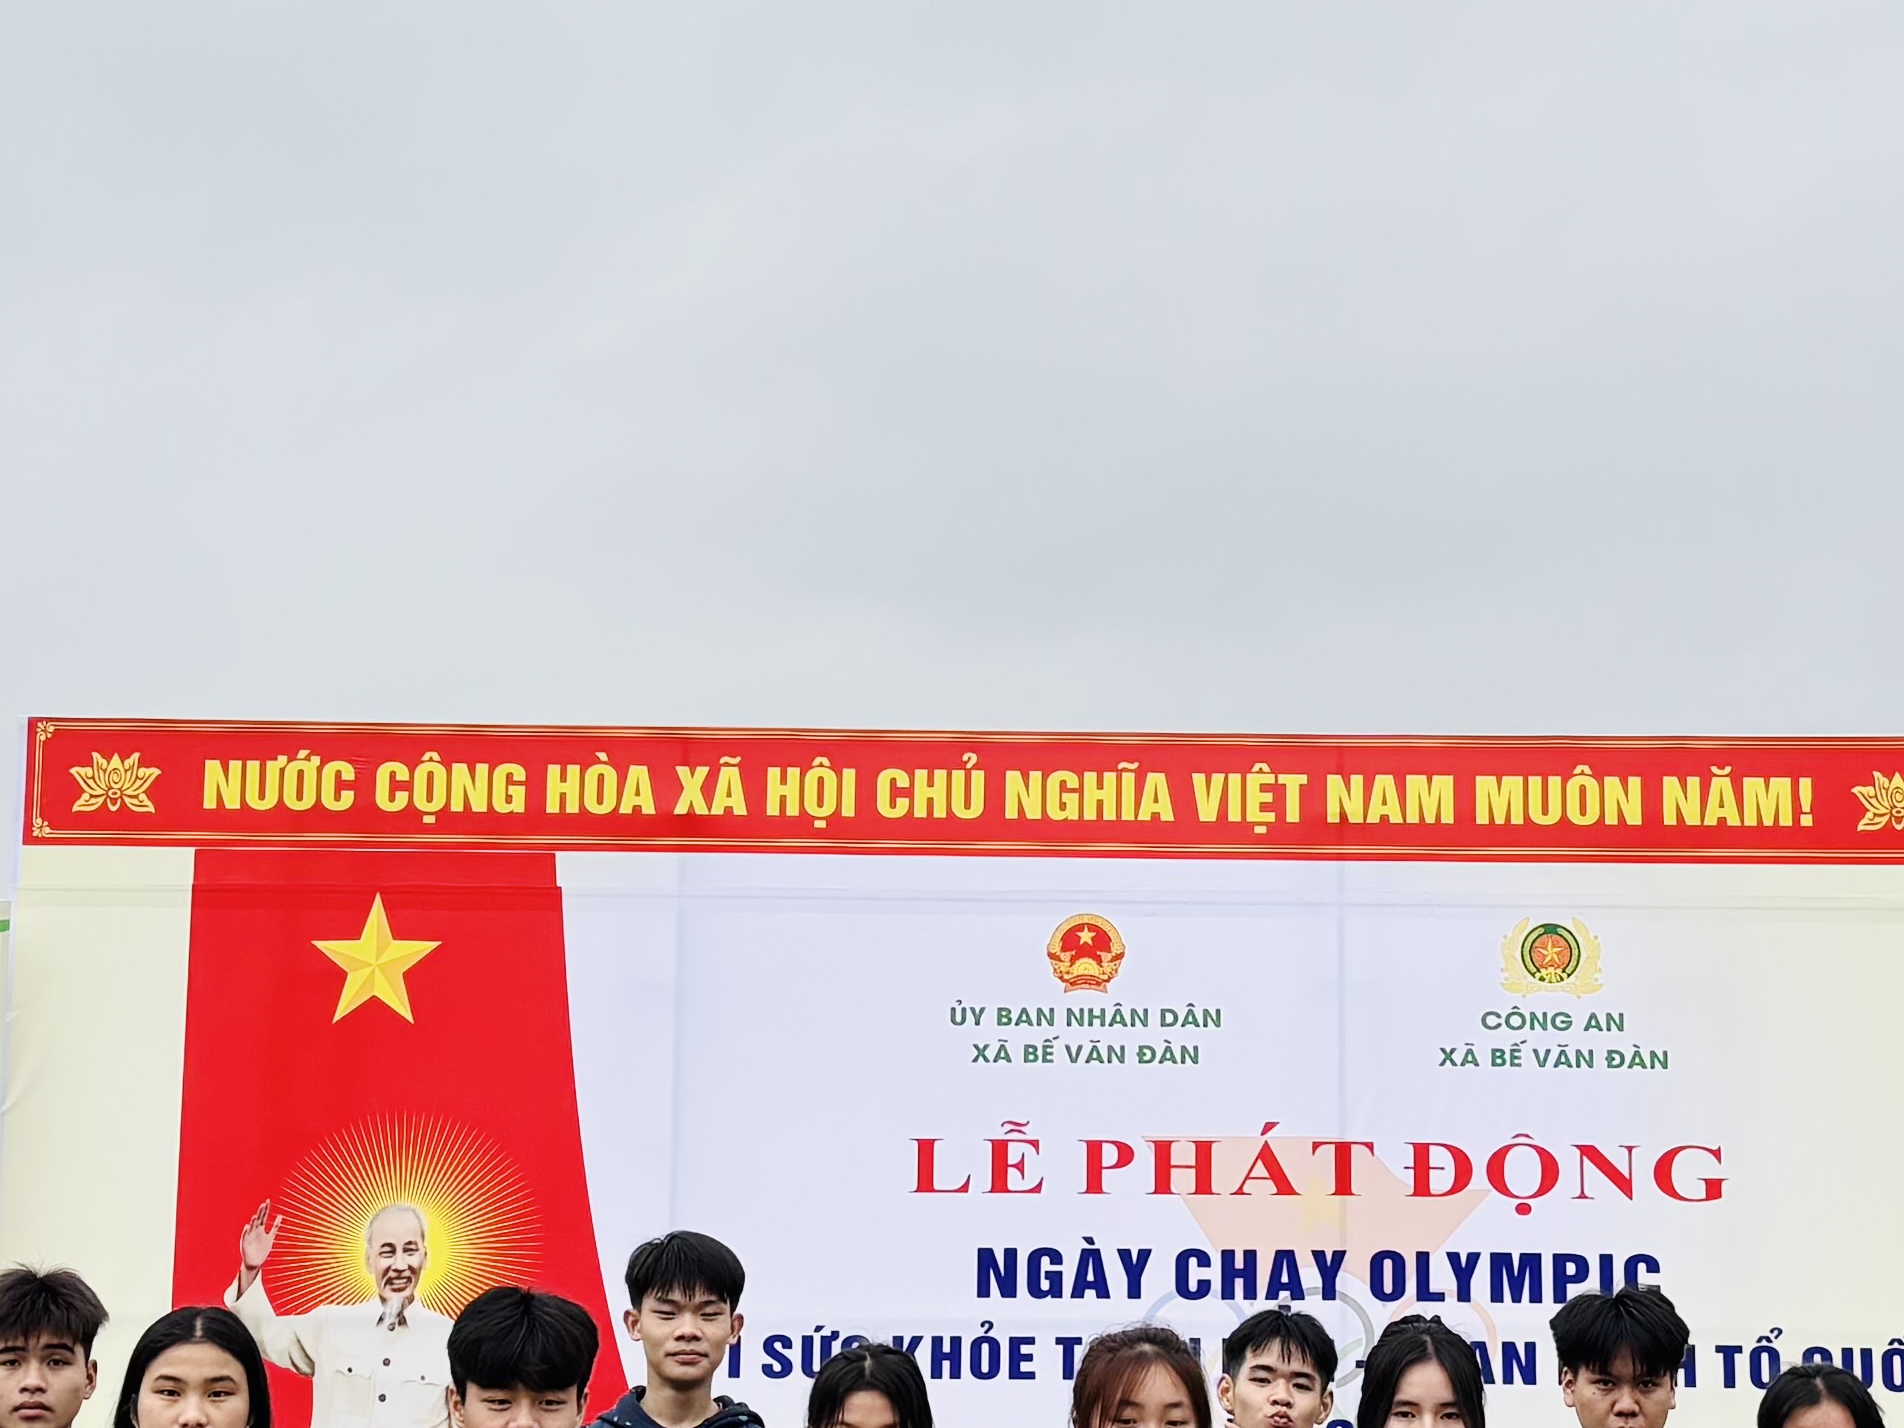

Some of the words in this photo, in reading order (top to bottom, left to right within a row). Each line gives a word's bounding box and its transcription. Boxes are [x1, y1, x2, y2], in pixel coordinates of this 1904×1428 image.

[202, 750, 356, 811] NƯỚC
[375, 752, 527, 824] CỘNG
[547, 753, 656, 815] HÒA
[676, 756, 748, 817] XÃ
[766, 757, 855, 829] HỘI
[876, 753, 985, 820] CHỦ
[1006, 762, 1175, 821] NGHĨA
[1192, 763, 1307, 833] VIỆT
[1326, 775, 1454, 824] NAM
[1476, 765, 1643, 826] MUÔN
[1663, 765, 1813, 827] NĂM!
[949, 1004, 986, 1028] ỦY
[996, 1007, 1055, 1028] BAN
[1065, 1003, 1149, 1028] NHÂN
[1159, 1003, 1222, 1029] DÂN
[1481, 1006, 1573, 1032] CÔNG
[1583, 1012, 1625, 1032] AN
[971, 1040, 1012, 1064] XÃ
[1023, 1036, 1061, 1065] BẾ
[1064, 1040, 1126, 1065] VĂN
[1135, 1040, 1201, 1066] ĐÀN
[1438, 1044, 1480, 1068] XÃ
[1491, 1040, 1529, 1069] BẾ
[1533, 1044, 1594, 1070] VĂN
[1605, 1045, 1670, 1071] ĐÀN
[909, 1120, 1044, 1196] LỄ
[1078, 1121, 1375, 1197] PHÁT
[1404, 1133, 1729, 1217] ĐỘNG
[976, 1236, 1152, 1300] NGÀY
[1175, 1248, 1347, 1314] CHẠY
[1370, 1250, 1661, 1304] OLYMPIC
[1715, 1327, 1783, 1390] TỔ
